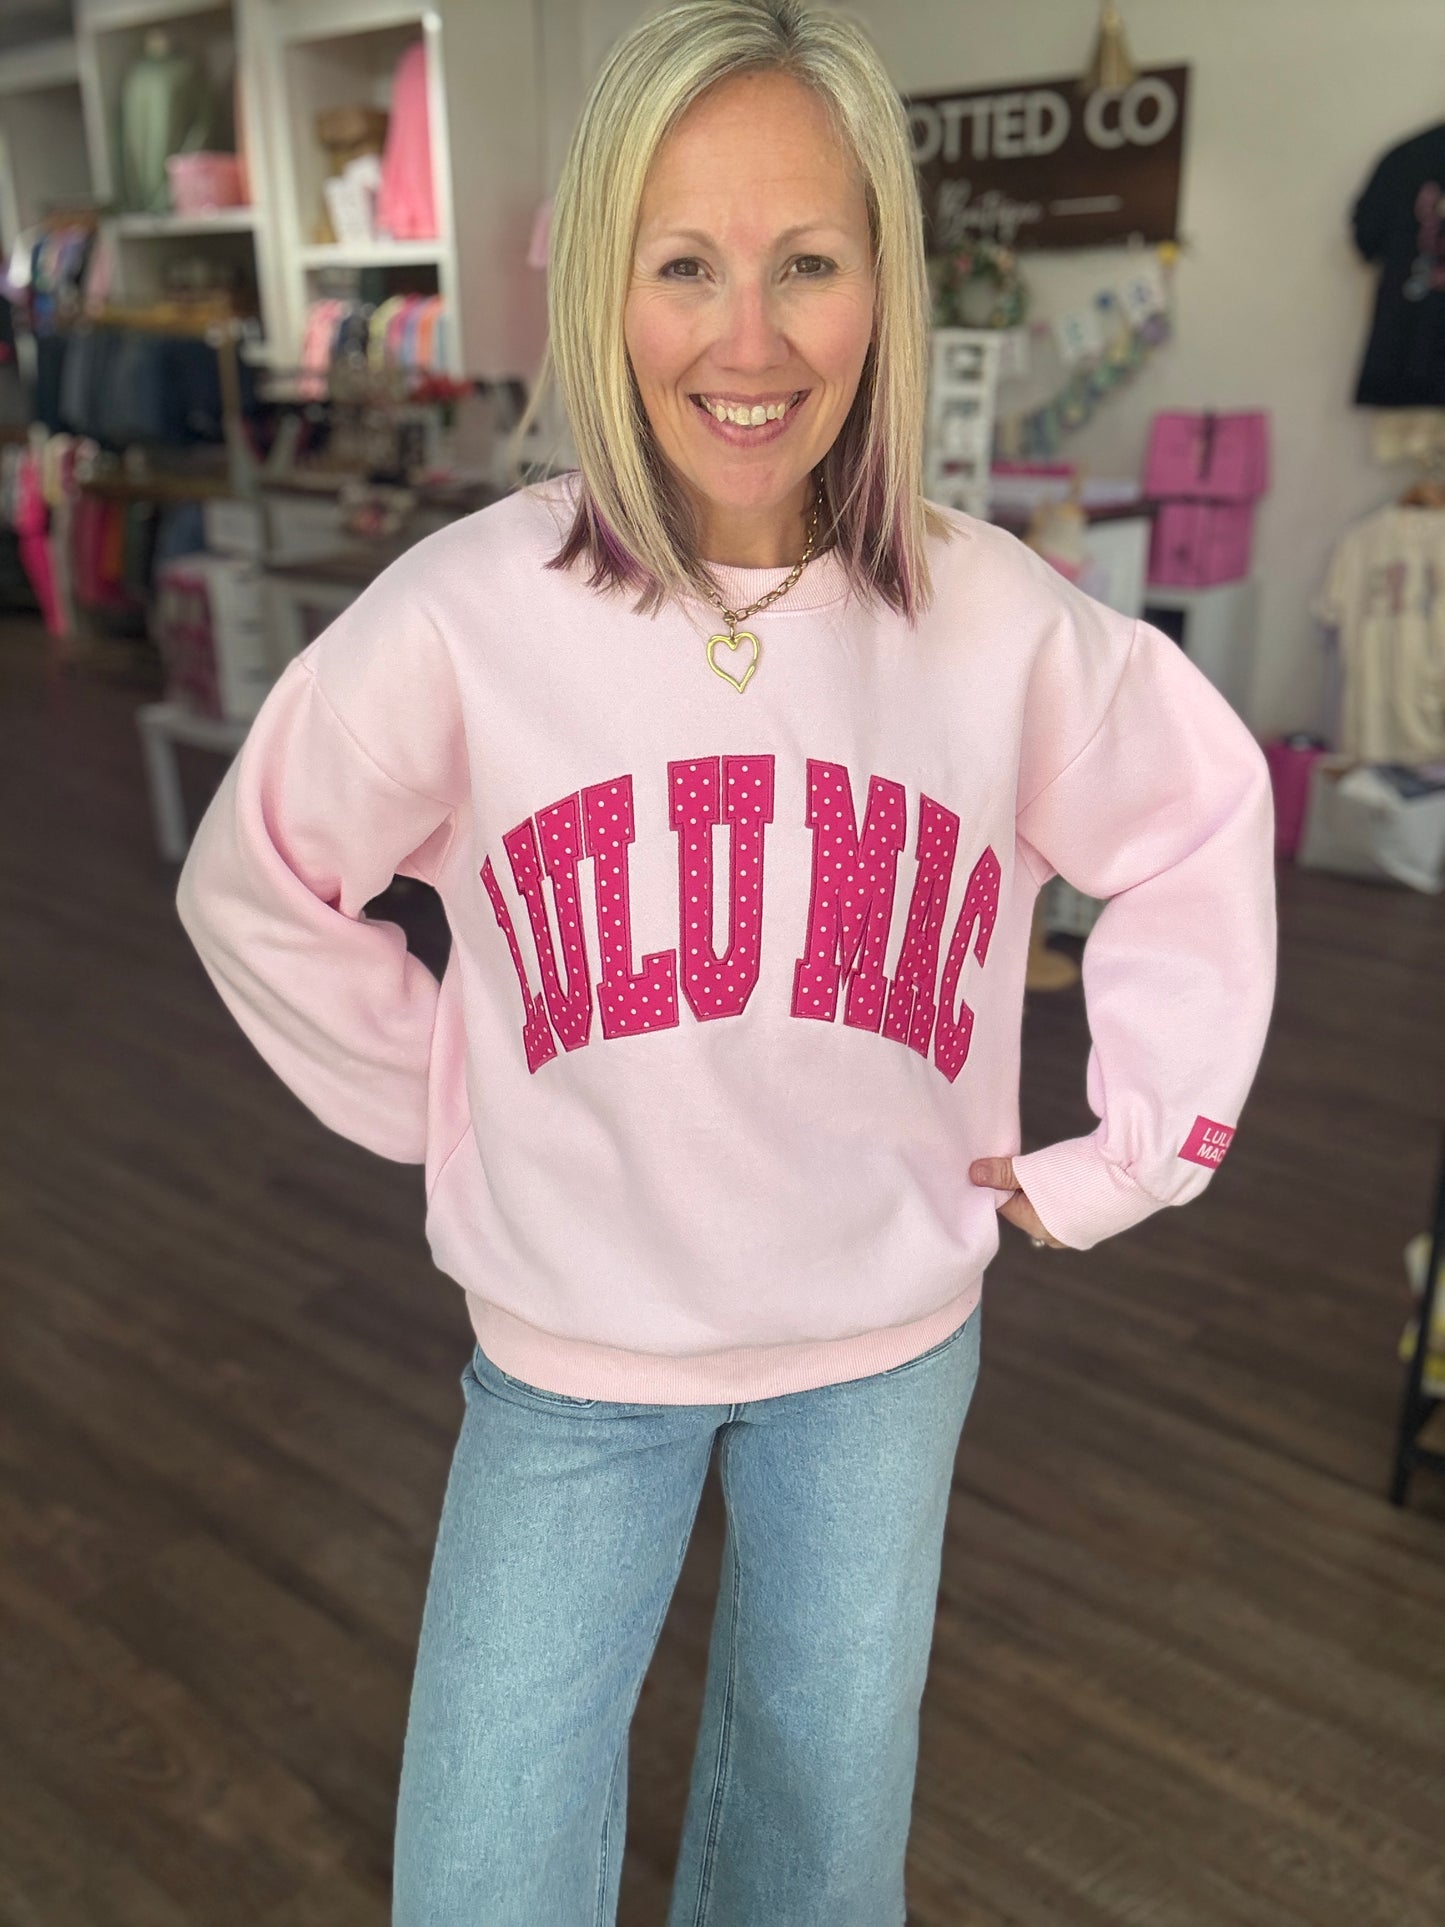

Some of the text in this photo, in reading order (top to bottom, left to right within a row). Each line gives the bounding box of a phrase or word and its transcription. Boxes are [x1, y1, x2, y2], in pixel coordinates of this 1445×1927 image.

[1084, 78, 1177, 148] CO
[480, 755, 1002, 1083] LULU MAC
